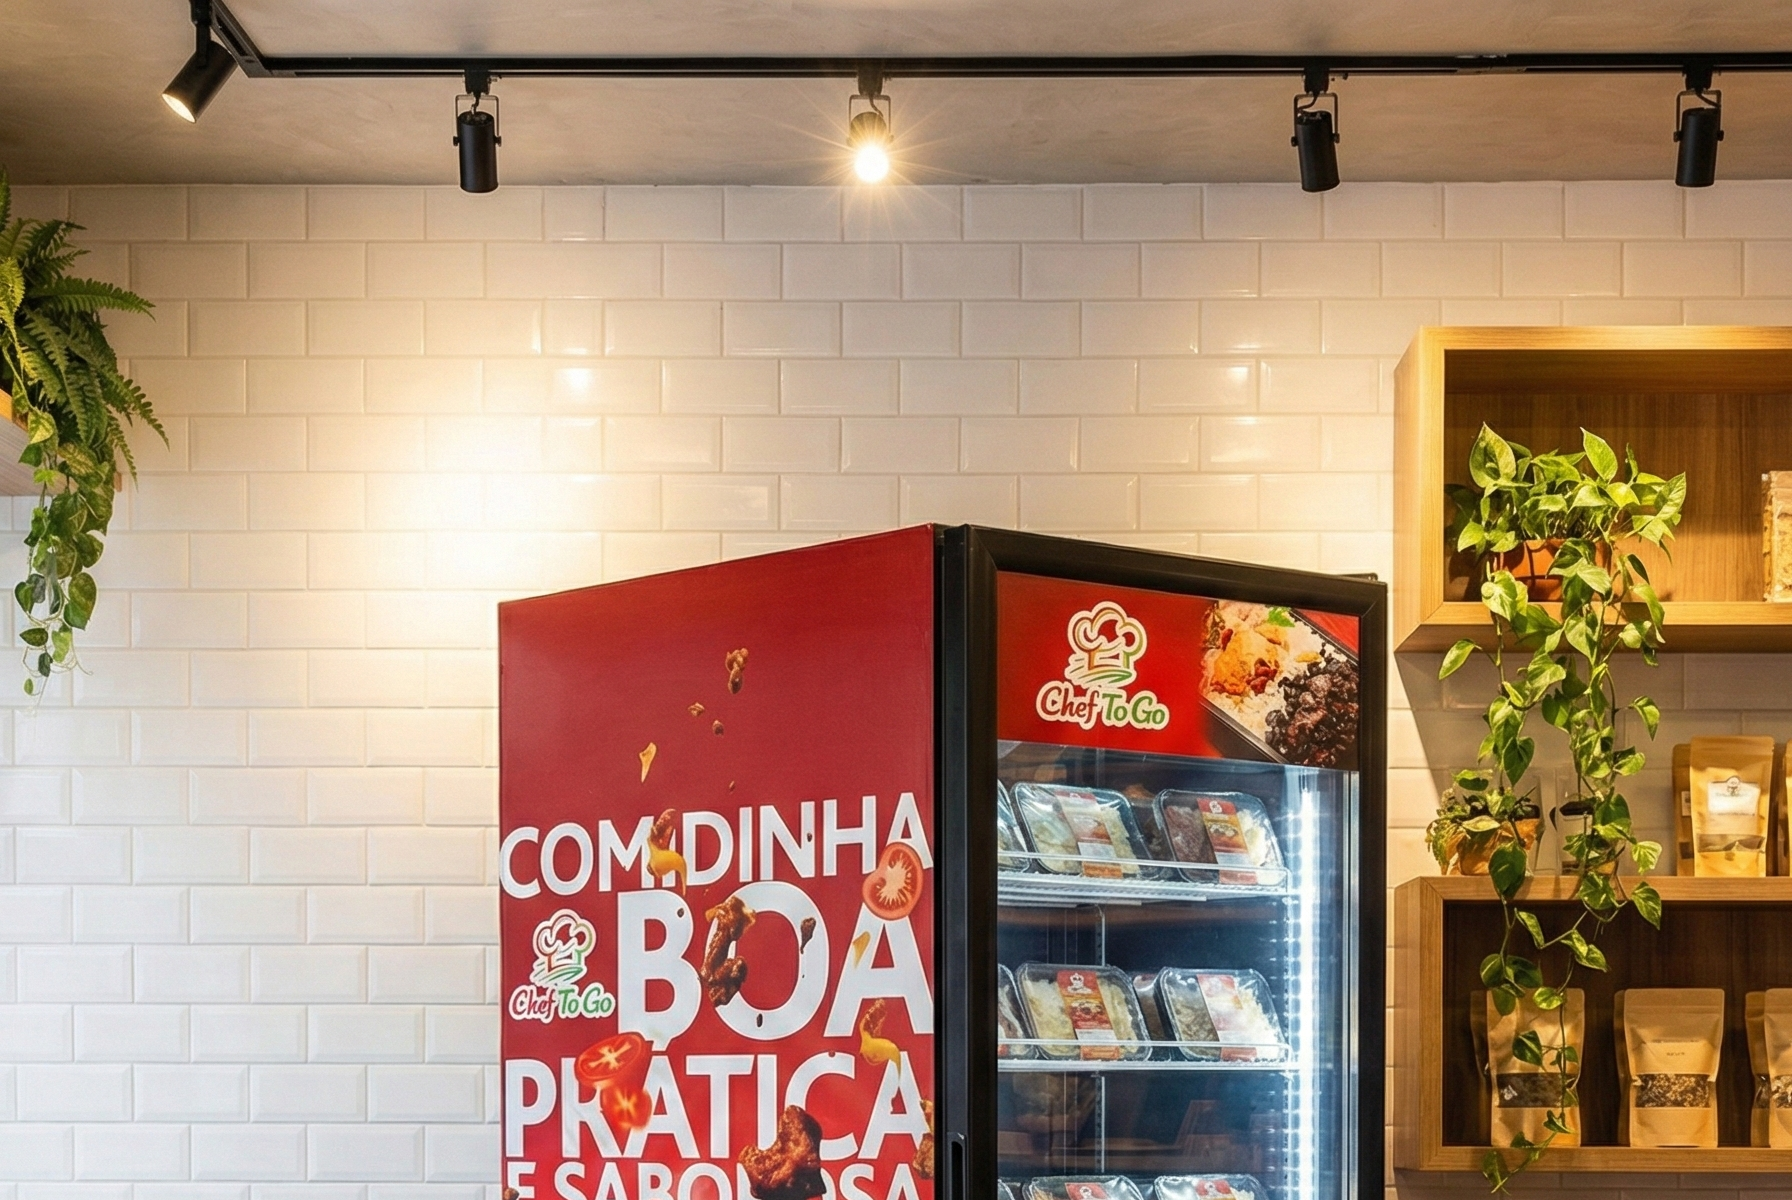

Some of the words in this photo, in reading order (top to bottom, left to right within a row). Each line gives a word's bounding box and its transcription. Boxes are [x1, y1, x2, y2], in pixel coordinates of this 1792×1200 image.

[1040, 686, 1099, 724] Chef
[1102, 693, 1128, 721] To
[1131, 696, 1165, 725] Go
[500, 791, 934, 899] COMDINHA
[617, 880, 934, 1041] BOA
[512, 989, 556, 1019] Chef
[558, 988, 579, 1014] To
[583, 987, 612, 1014] Go
